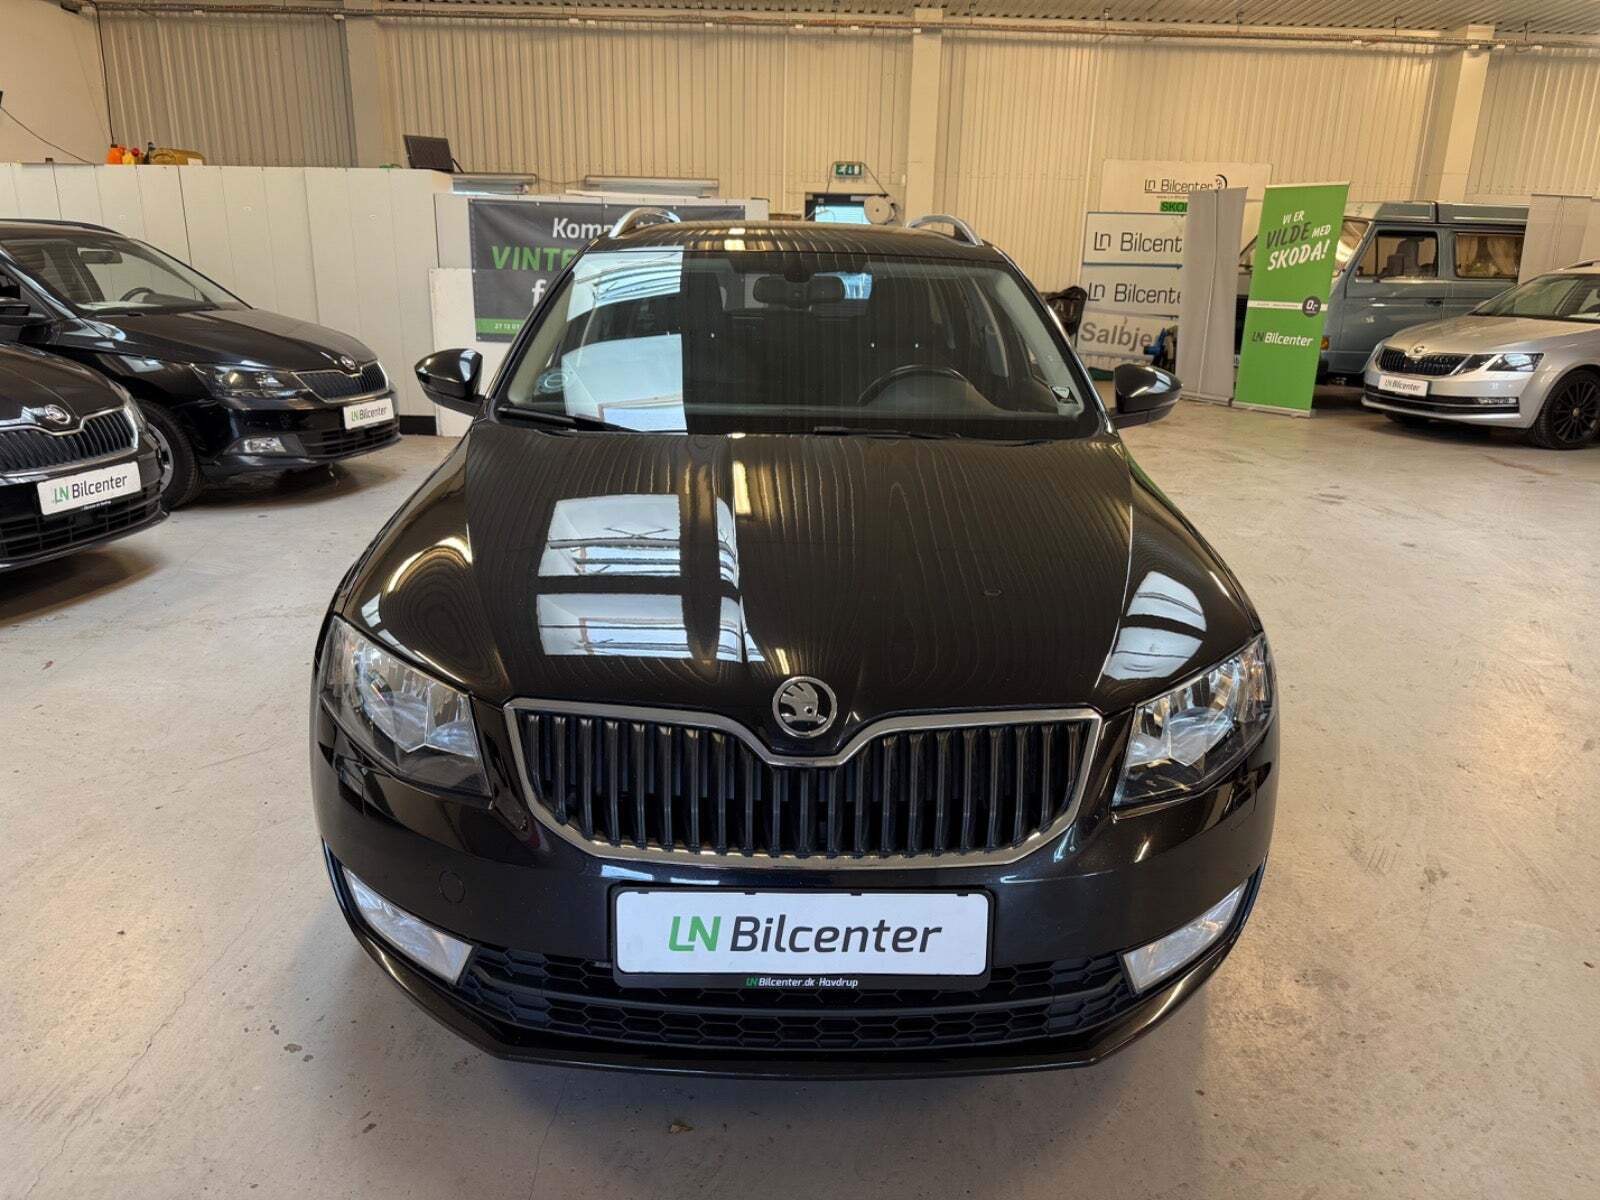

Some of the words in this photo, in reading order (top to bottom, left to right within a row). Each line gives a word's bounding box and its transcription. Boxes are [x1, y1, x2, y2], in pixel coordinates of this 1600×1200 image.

[1282, 213, 1292, 225] VI
[1293, 210, 1305, 222] ER
[1266, 221, 1312, 249] VILDE
[1311, 224, 1331, 238] MED
[1267, 239, 1330, 271] SKODA!
[53, 485, 70, 504] LN
[72, 475, 128, 499] Bilcenter
[668, 915, 722, 952] LN
[729, 914, 943, 953] Bilcenter
[818, 977, 859, 989] Havdrup
